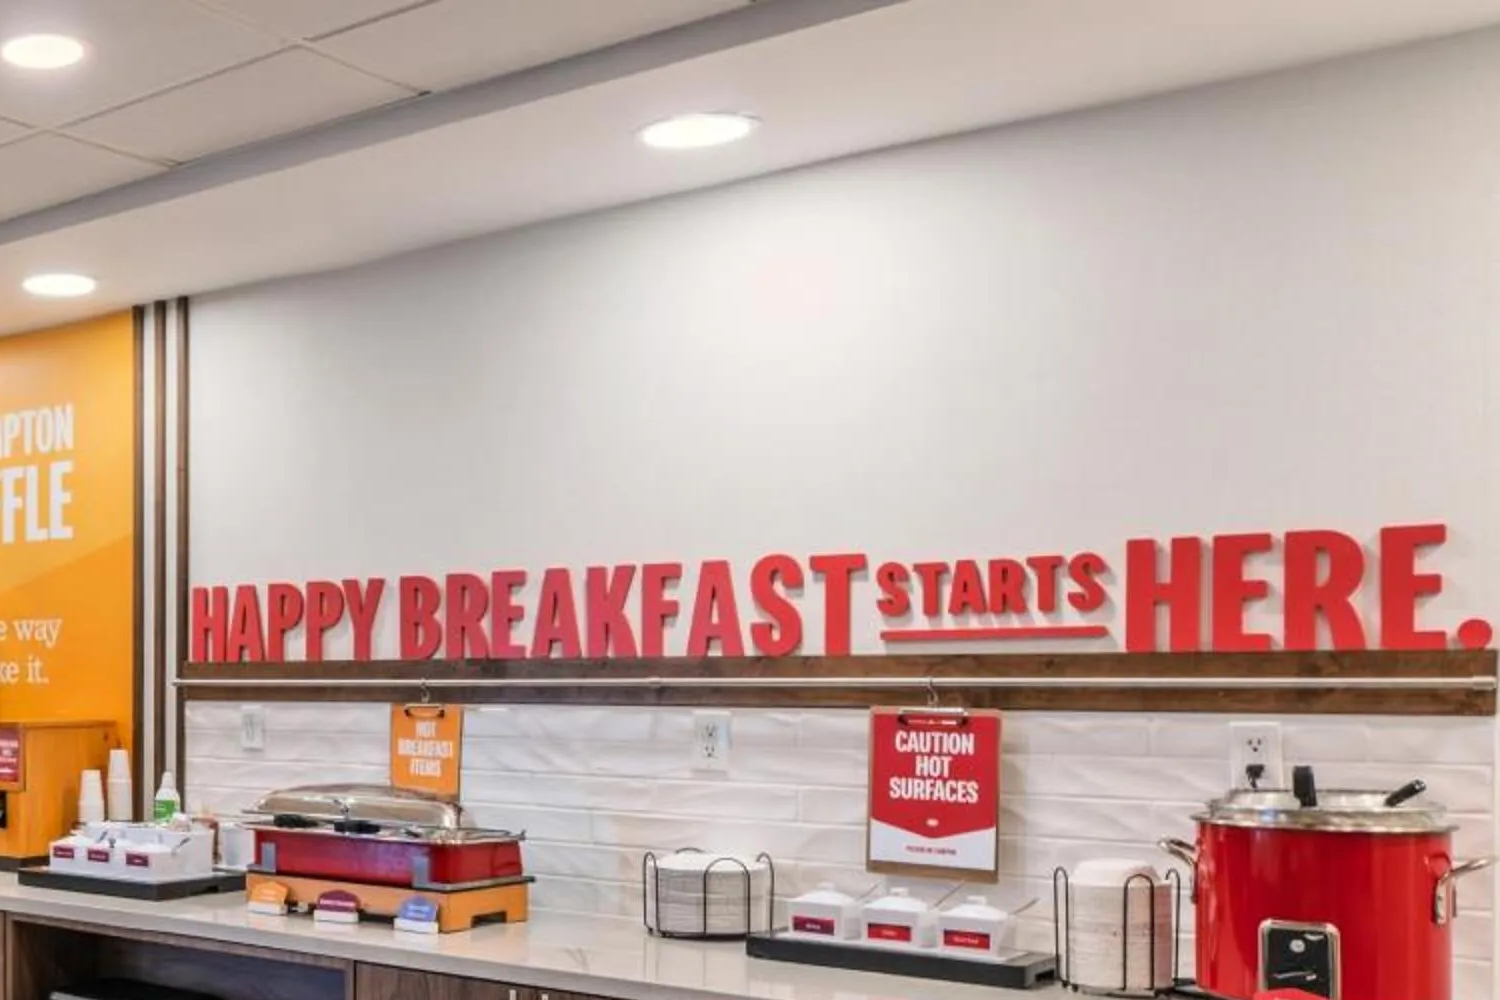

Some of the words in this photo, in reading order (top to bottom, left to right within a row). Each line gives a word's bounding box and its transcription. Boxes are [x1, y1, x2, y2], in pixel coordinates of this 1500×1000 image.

[192, 578, 385, 662] HAPPY
[401, 553, 867, 662] BREAKFAST
[876, 552, 1108, 619] STARTS
[1126, 524, 1494, 654] HERE.
[12, 616, 63, 648] way
[27, 654, 49, 685] it.
[415, 721, 436, 737] HOT
[398, 737, 453, 758] BREAKFAST
[895, 730, 975, 755] CAUTION
[410, 758, 441, 777] ITEMS
[915, 755, 953, 778] HOT
[889, 776, 979, 804] SURFACES
